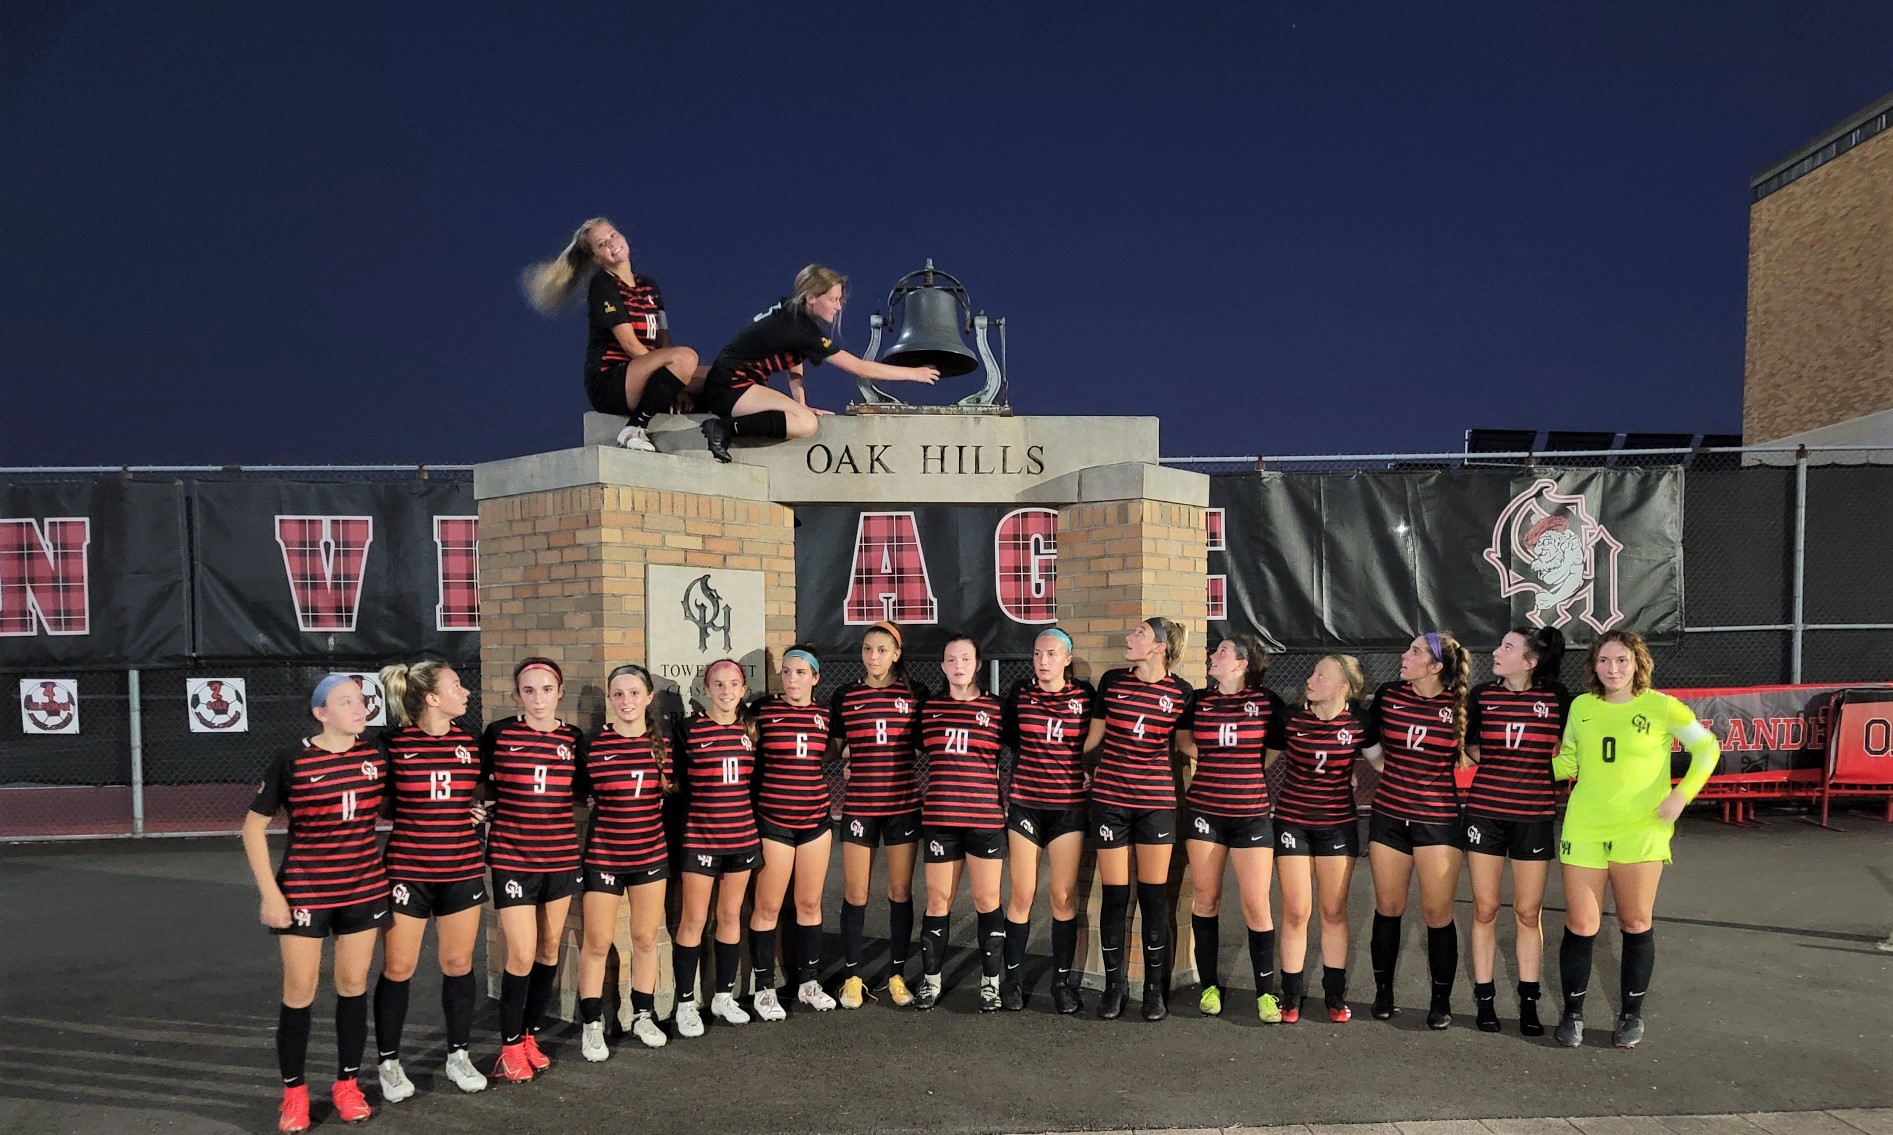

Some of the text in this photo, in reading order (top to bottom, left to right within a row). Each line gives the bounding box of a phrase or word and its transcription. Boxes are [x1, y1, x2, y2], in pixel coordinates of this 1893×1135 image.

[645, 313, 657, 340] 18
[806, 444, 1046, 476] OAK HILLS
[660, 664, 707, 678] TOWE
[210, 683, 223, 699] 2
[876, 719, 888, 745] 8
[1046, 717, 1064, 743] 14
[1132, 714, 1146, 740] 4
[1218, 723, 1238, 748] 16
[1406, 724, 1428, 751] 12
[1505, 722, 1526, 749] 17
[796, 733, 808, 758] 6
[944, 728, 969, 754] 20
[1602, 736, 1616, 763] 0
[722, 757, 739, 784] 10
[1315, 751, 1328, 774] 2
[430, 771, 451, 800] 13
[533, 765, 547, 794] 9
[631, 770, 644, 798] 7
[342, 790, 356, 821] 11
